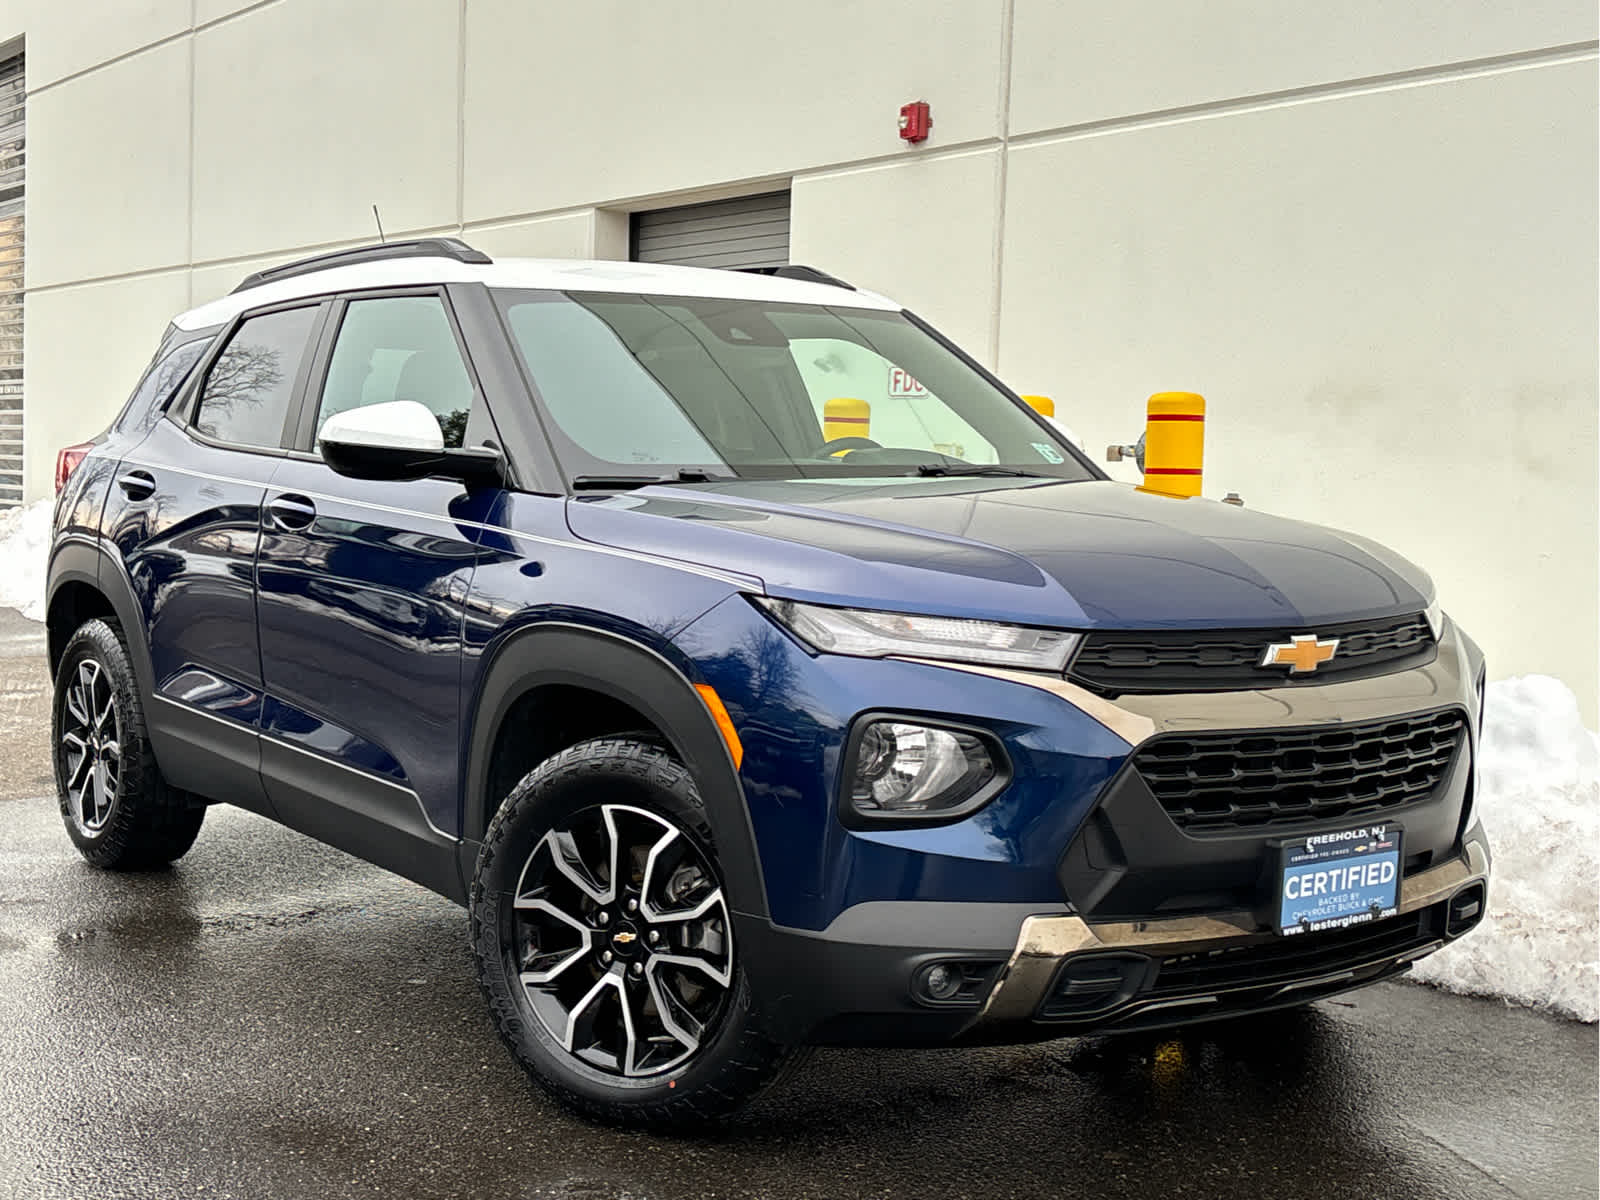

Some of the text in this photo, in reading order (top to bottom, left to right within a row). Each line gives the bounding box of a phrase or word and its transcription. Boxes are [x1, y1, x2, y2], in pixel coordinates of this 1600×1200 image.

[1371, 825, 1385, 836] NJ
[1285, 861, 1395, 900] CERTIFIED
[1318, 892, 1361, 906] BACKED BY
[1337, 900, 1361, 912] BUICK
